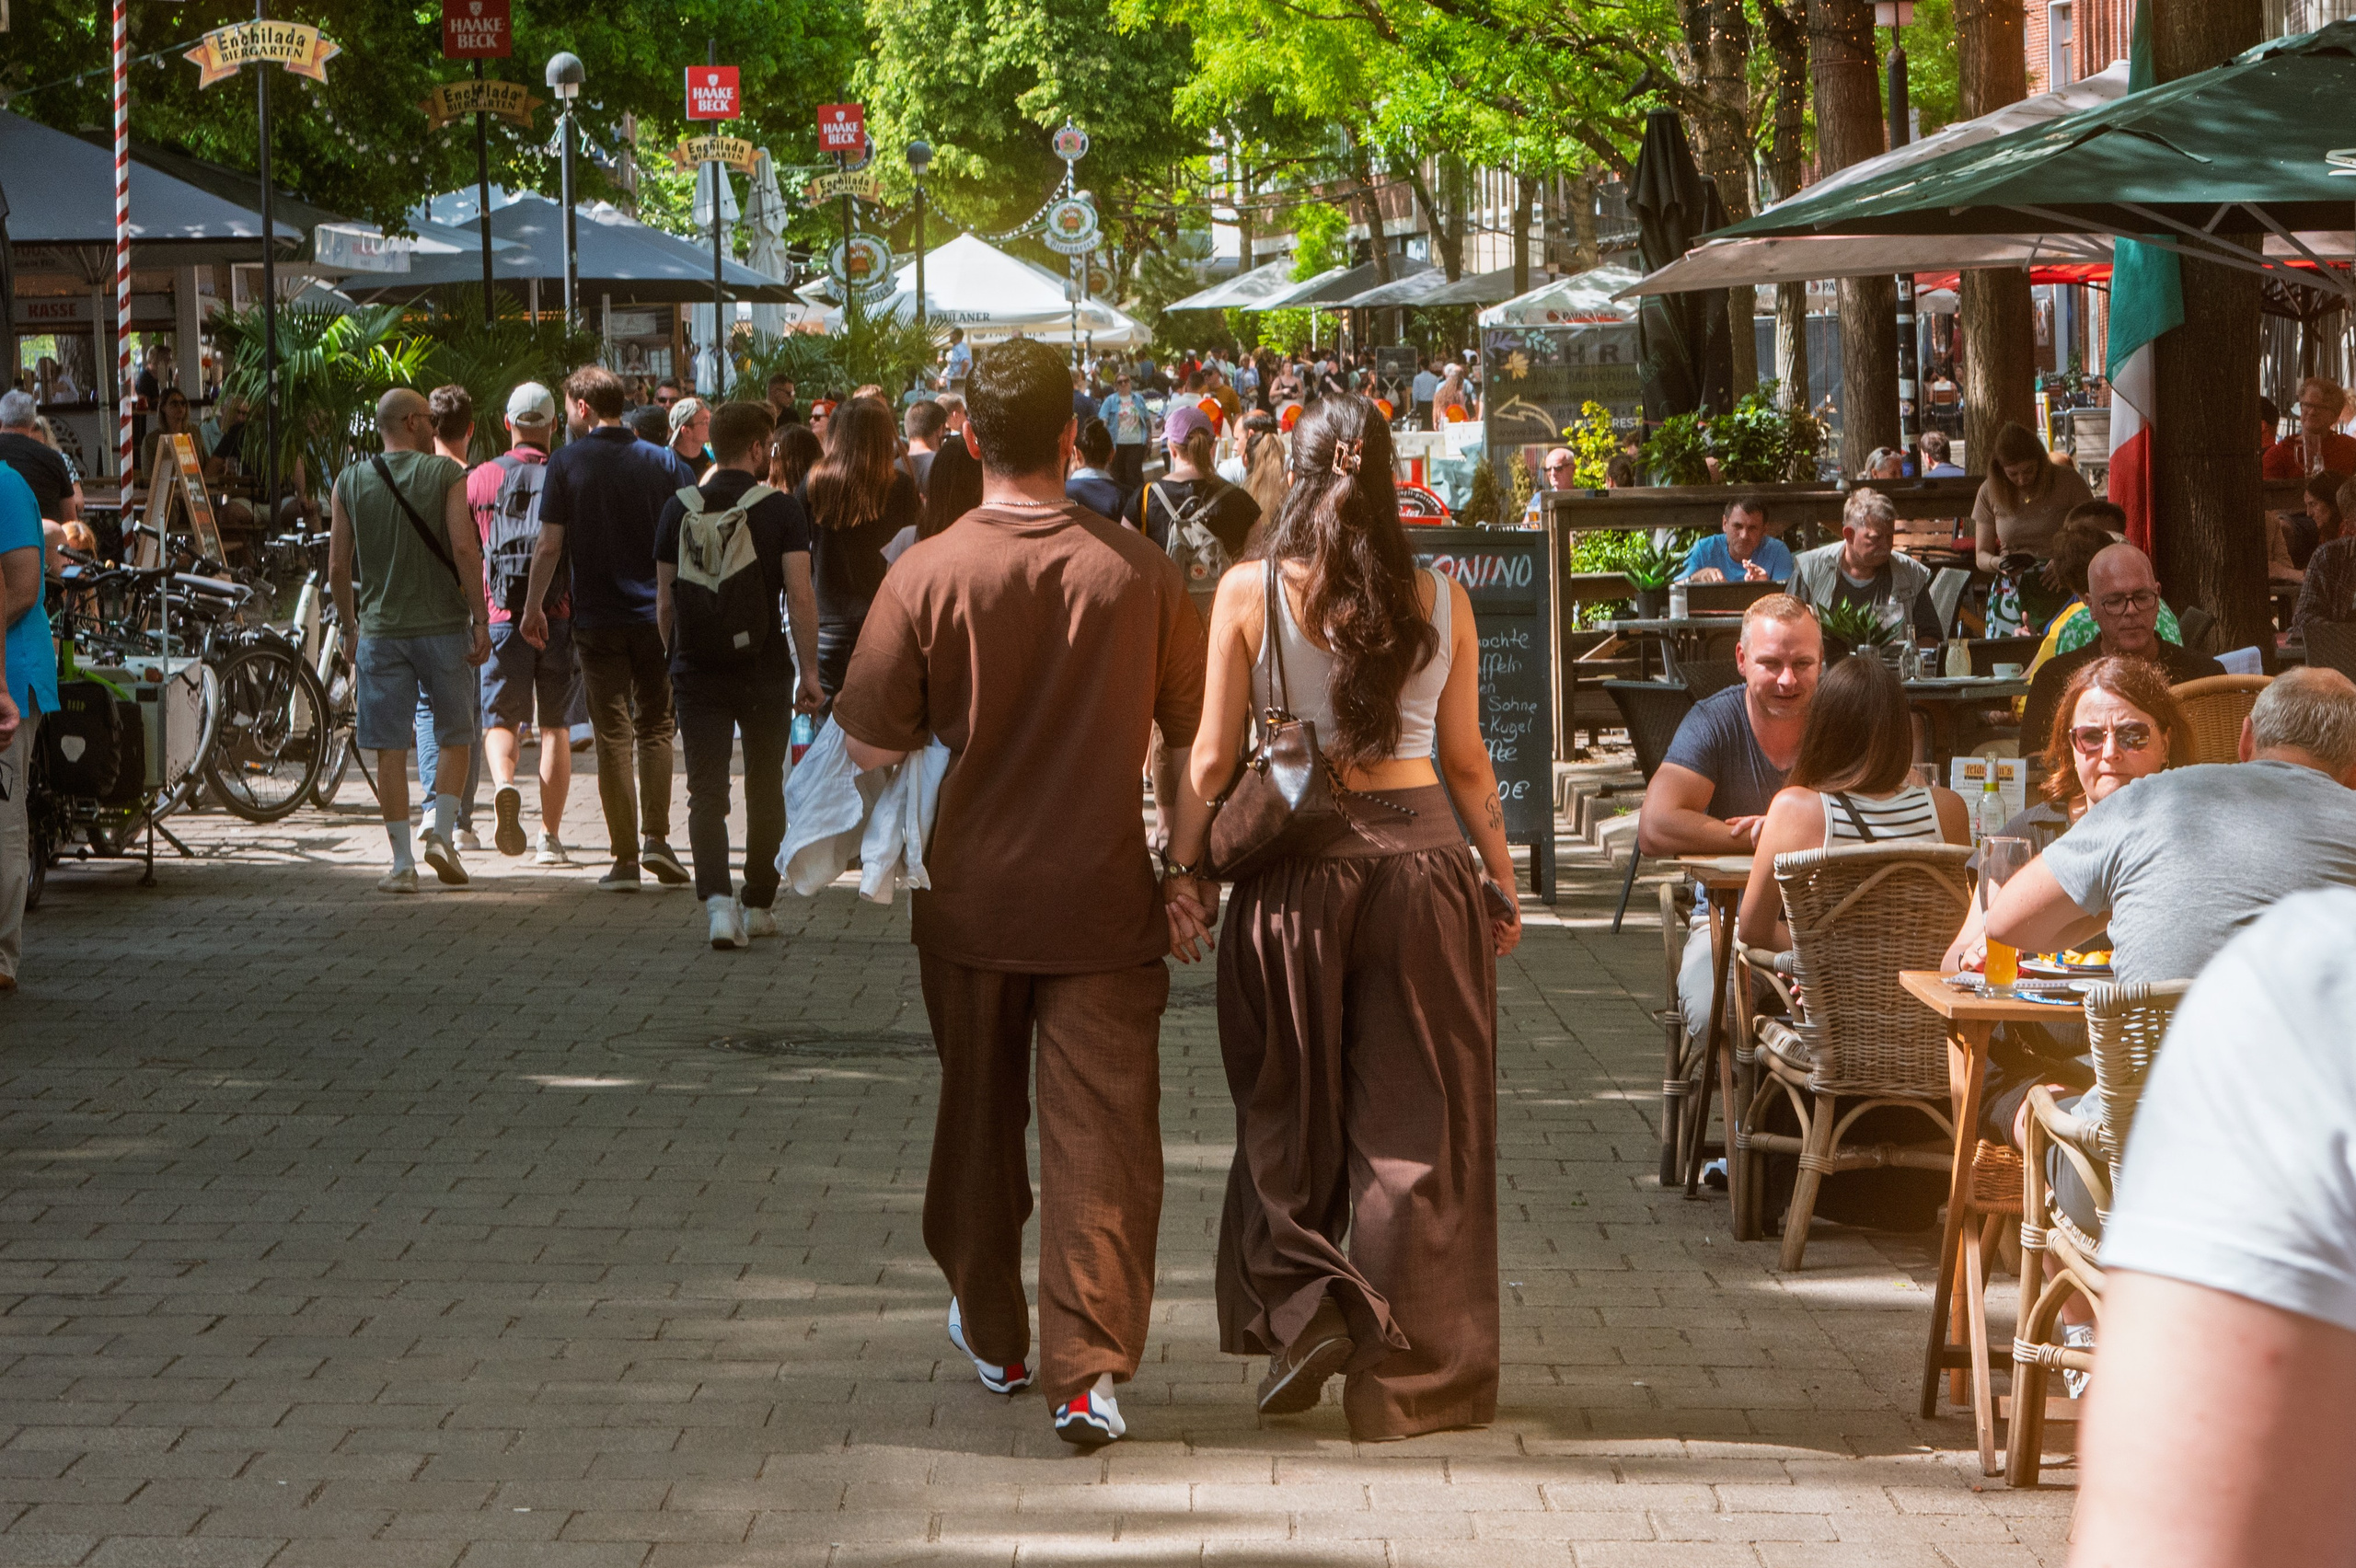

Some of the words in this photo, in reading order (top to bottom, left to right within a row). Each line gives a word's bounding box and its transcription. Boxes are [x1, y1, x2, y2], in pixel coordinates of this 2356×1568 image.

[450, 17, 503, 33] HAAKE
[217, 27, 306, 51] Enchilada
[457, 33, 497, 49] BECK
[221, 46, 304, 63] BIERGARTEN
[693, 86, 733, 100] HAAKE
[698, 99, 730, 112] BECK
[823, 121, 859, 134] HAAKE
[687, 139, 745, 154] Enchilada
[828, 133, 856, 145] BECK
[28, 304, 76, 318] KASSE
[930, 312, 990, 322] PAULANER
[1478, 628, 1529, 649] achte
[1479, 683, 1496, 694] en
[1490, 715, 1532, 744] Kugel
[1498, 780, 1530, 801] 0€
